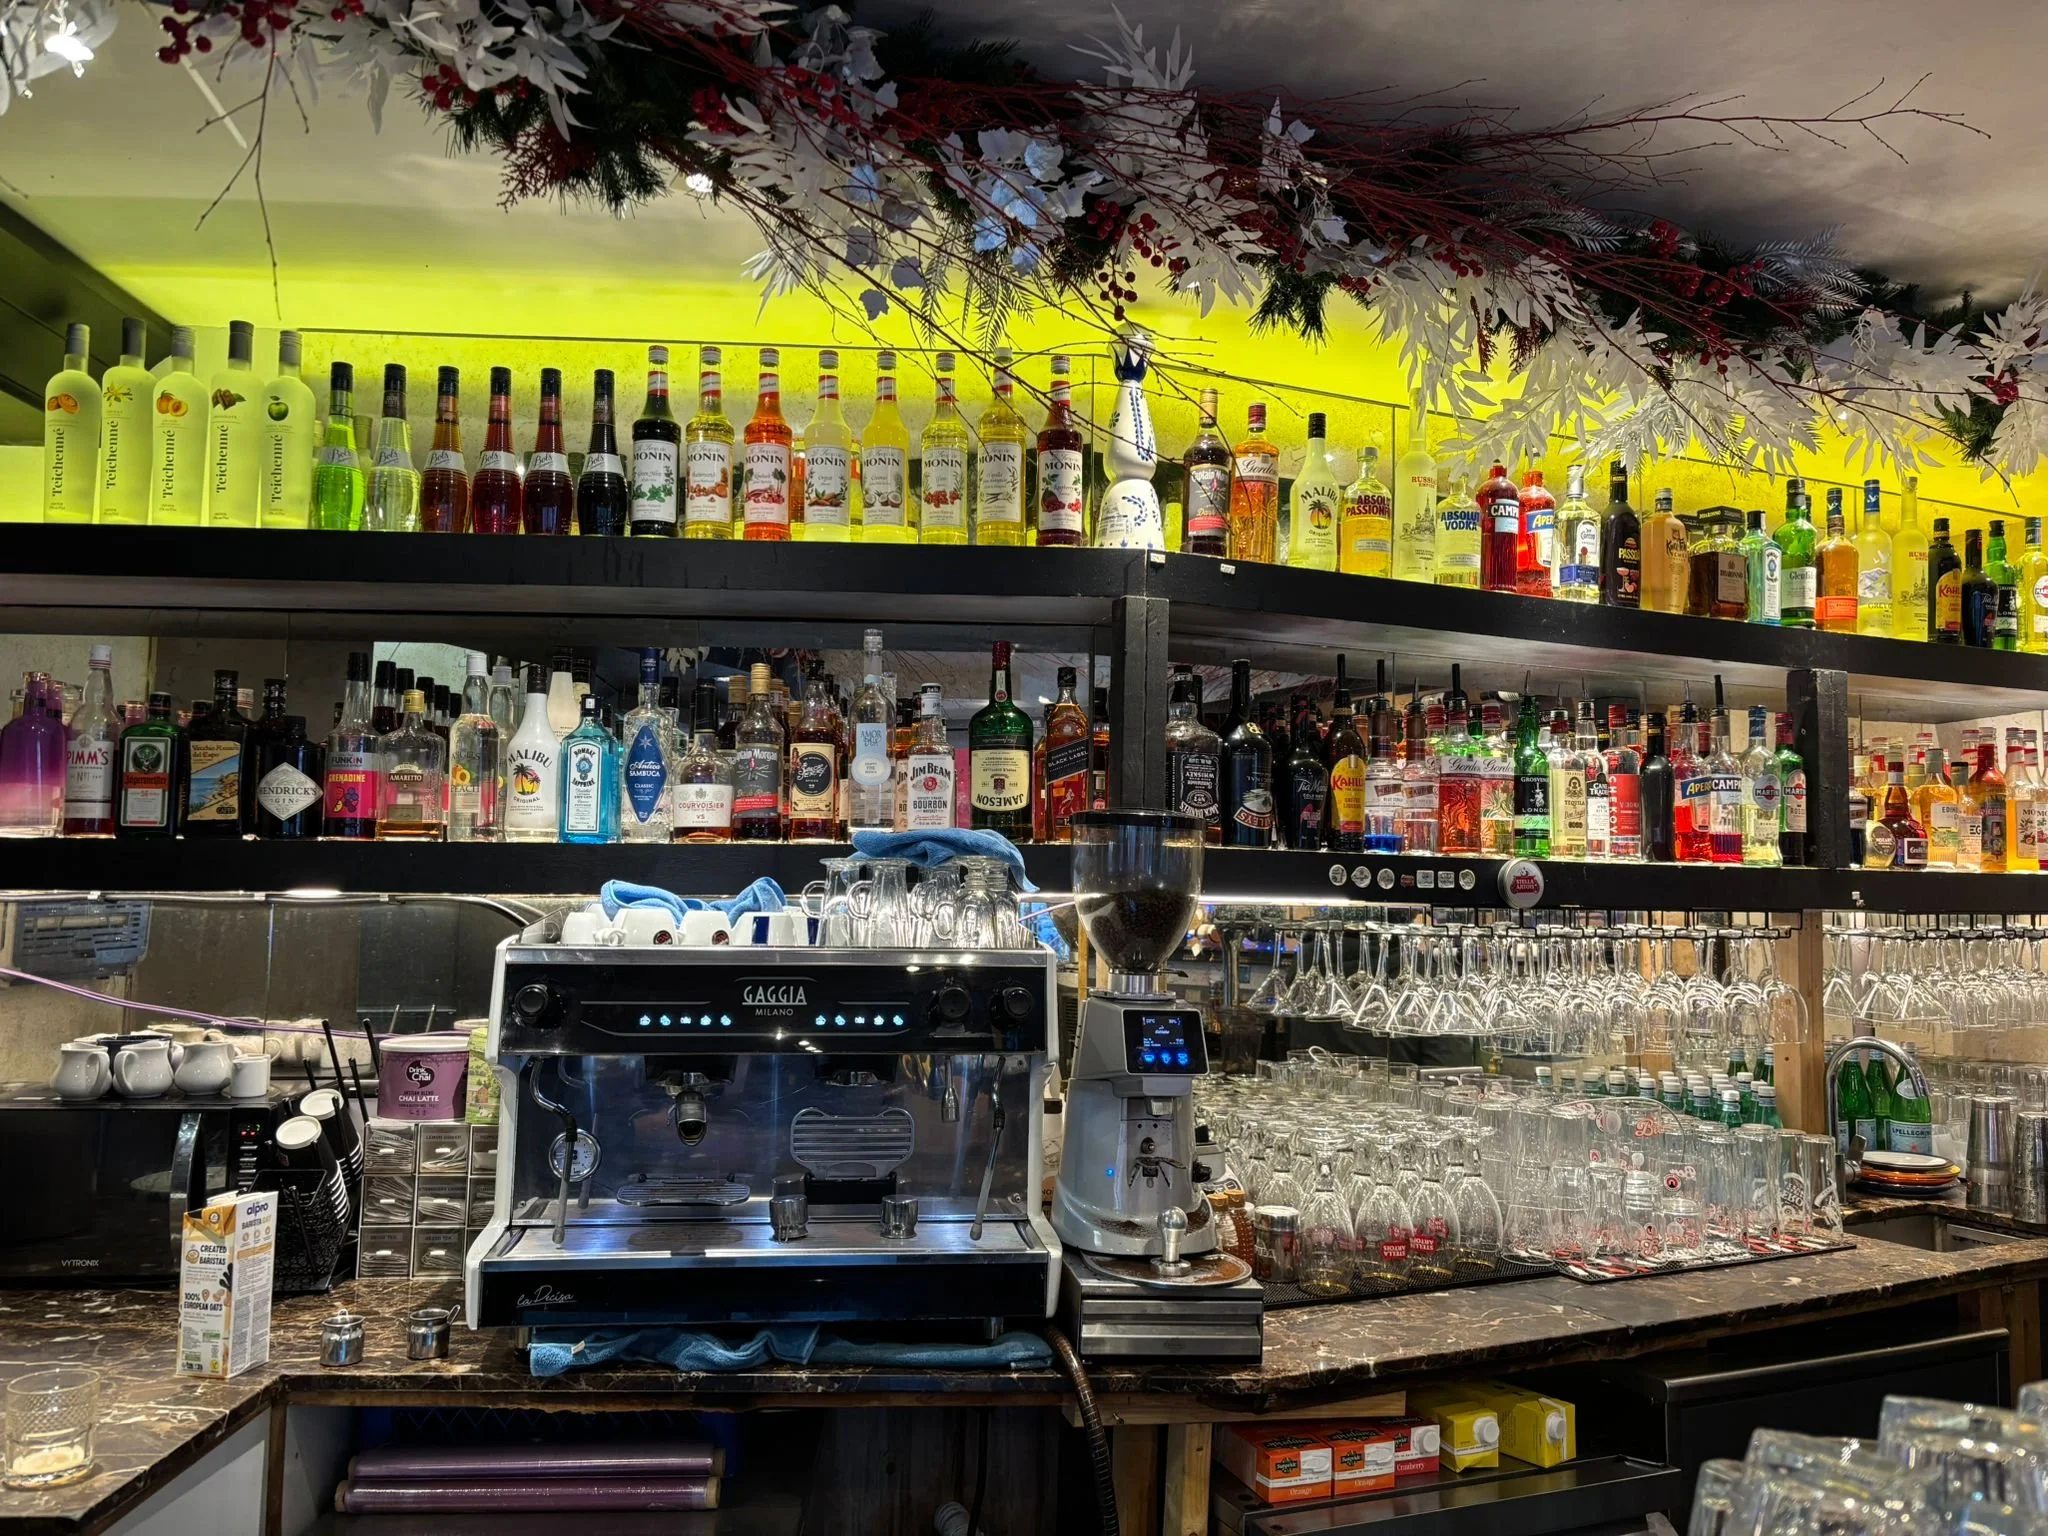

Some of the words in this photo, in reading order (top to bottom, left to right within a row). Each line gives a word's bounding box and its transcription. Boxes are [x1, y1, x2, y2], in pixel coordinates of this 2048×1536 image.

[106, 420, 119, 489] Teichenné
[216, 424, 229, 493] Teichenné
[634, 452, 671, 462] MONIN
[688, 453, 725, 462] MONIN
[745, 454, 783, 464] MONIN
[980, 454, 1015, 464] MONIN
[52, 427, 65, 497] Teichenné
[162, 429, 175, 498] Teichenné
[808, 457, 846, 466] MONIN
[864, 458, 900, 467] MONIN
[924, 458, 962, 468] MONIN
[1045, 462, 1081, 470] MONIN
[271, 434, 283, 503] Teichenné
[1444, 521, 1477, 531] VODKA
[66, 748, 109, 766] PIMM'S
[573, 748, 596, 757] BOMBAY
[753, 750, 777, 762] Morgan
[331, 756, 362, 764] FUNKIN
[509, 749, 552, 769] MALIBU
[1048, 757, 1068, 768] BLACK
[1069, 750, 1088, 760] LABEL
[910, 764, 926, 781] JIM
[927, 762, 951, 780] BEAM
[328, 773, 366, 784] GRENADINE
[572, 779, 595, 787] SAPPHIRE
[913, 800, 947, 809] BOURBON
[976, 793, 1024, 807] JAMESON
[1609, 776, 1617, 834] CHEKOV
[1204, 802, 1220, 818] JACK
[742, 985, 808, 1004] GAGGIA
[755, 1007, 794, 1017] MILANO
[412, 1073, 431, 1081] Chai
[246, 1202, 269, 1217] alpro
[242, 1219, 262, 1230] BARISTA
[200, 1244, 227, 1254] CREATED
[199, 1256, 226, 1265] BARISTAS
[184, 1293, 200, 1302] 100%
[533, 1285, 574, 1303] Decisa
[184, 1301, 209, 1311] EUROPEAN
[209, 1303, 223, 1311] OATS
[1396, 1462, 1425, 1471] Cranberry
[1354, 1478, 1376, 1487] Orange
[1290, 1487, 1312, 1496] Orange
